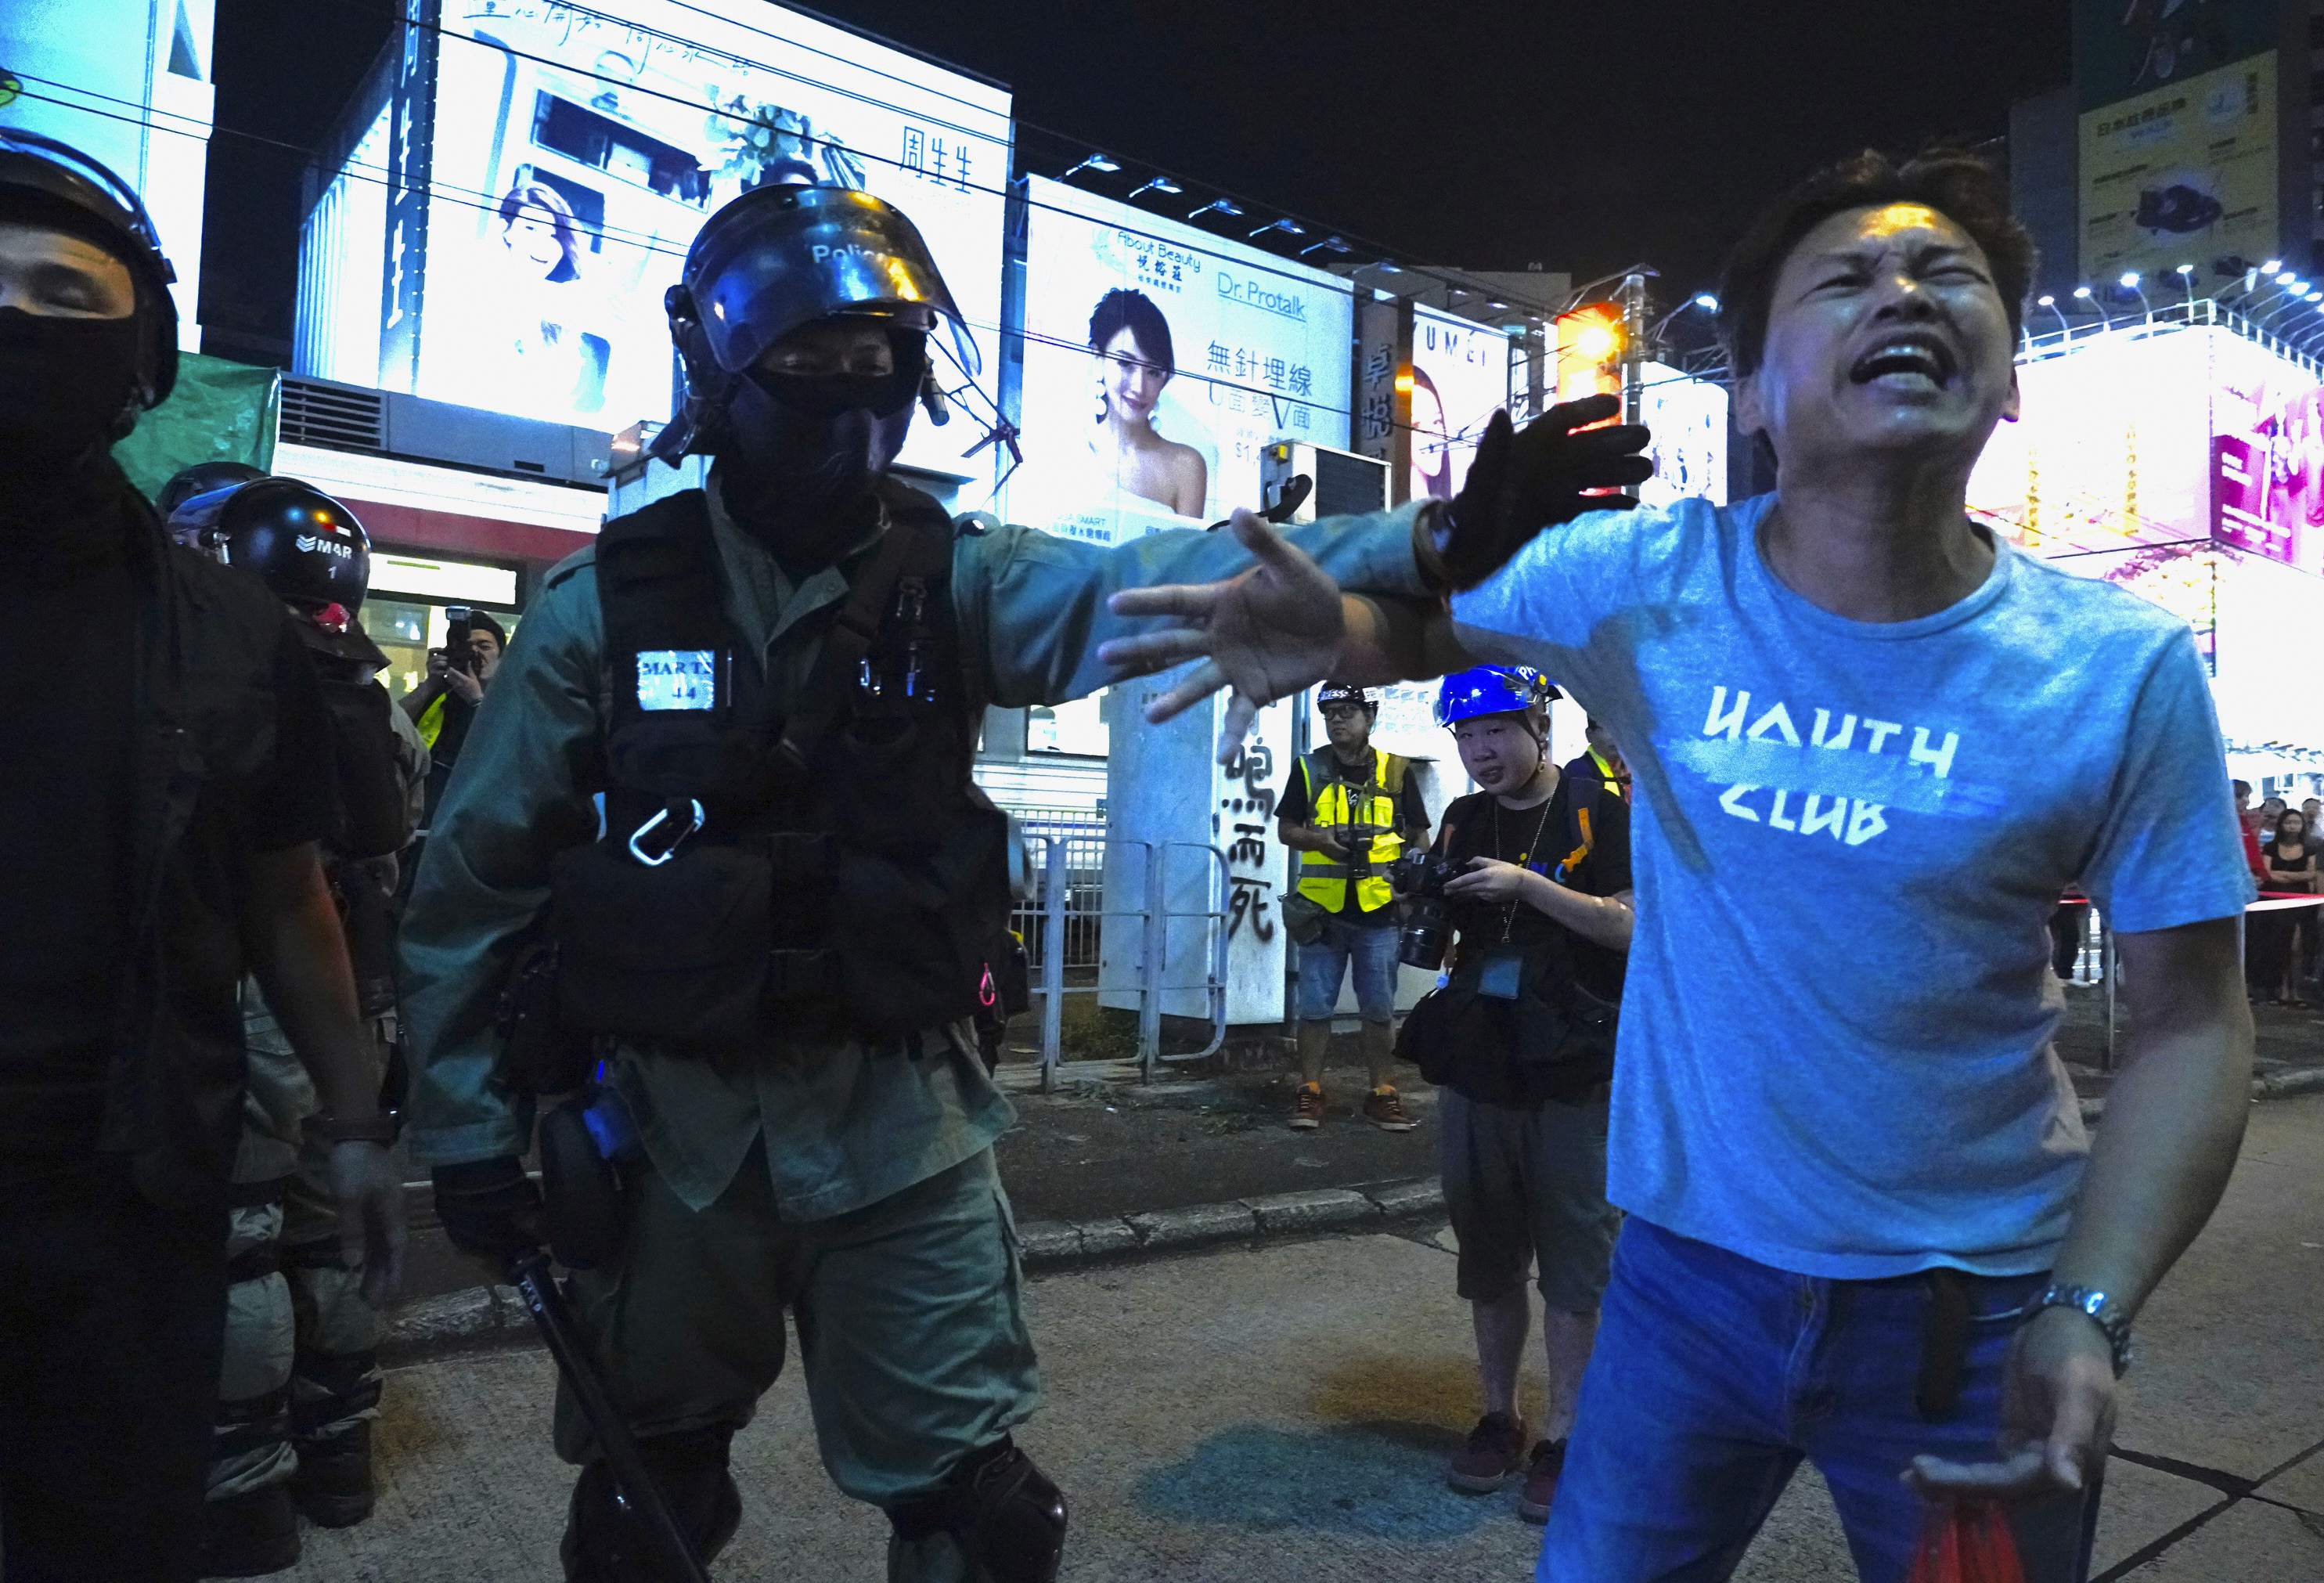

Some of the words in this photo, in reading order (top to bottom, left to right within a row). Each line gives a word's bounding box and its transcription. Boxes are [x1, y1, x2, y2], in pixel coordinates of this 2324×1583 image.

[899, 125, 972, 195] 周生生
[1158, 243, 1202, 273] Beauty
[1217, 271, 1243, 299] Dr.
[1247, 280, 1308, 319] Protalk
[1207, 340, 1312, 397] 無針埋線
[1718, 784, 1889, 846] CLUB
